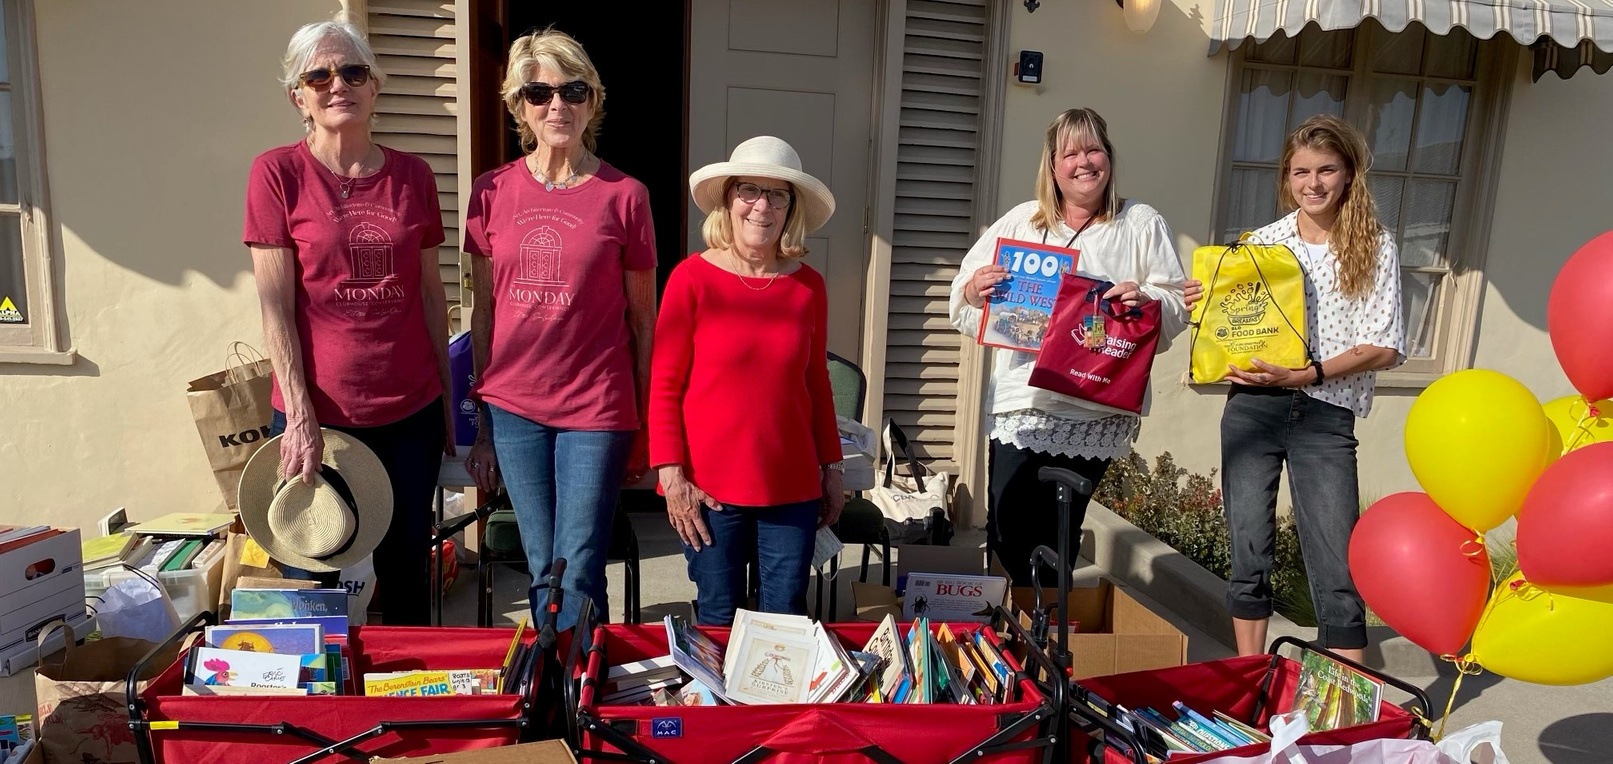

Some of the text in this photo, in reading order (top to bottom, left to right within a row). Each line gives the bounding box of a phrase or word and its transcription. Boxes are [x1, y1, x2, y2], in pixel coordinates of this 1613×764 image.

[1012, 251, 1059, 278] 100
[334, 285, 405, 301] MONDAY
[1018, 280, 1043, 295] THE
[509, 287, 576, 306] MONDAY
[1029, 295, 1056, 309] WES
[1230, 303, 1259, 315] Spring
[1231, 326, 1280, 338] FOOD BANK
[1105, 334, 1137, 352] aising
[1227, 343, 1269, 353] FOUNDATION
[1069, 368, 1087, 379] Read
[1087, 372, 1103, 383] With
[936, 584, 983, 597] BUGS
[1328, 663, 1361, 692] Life in the
[368, 684, 383, 694] The
[382, 678, 421, 692] Berenstain
[419, 683, 451, 697] FAIR
